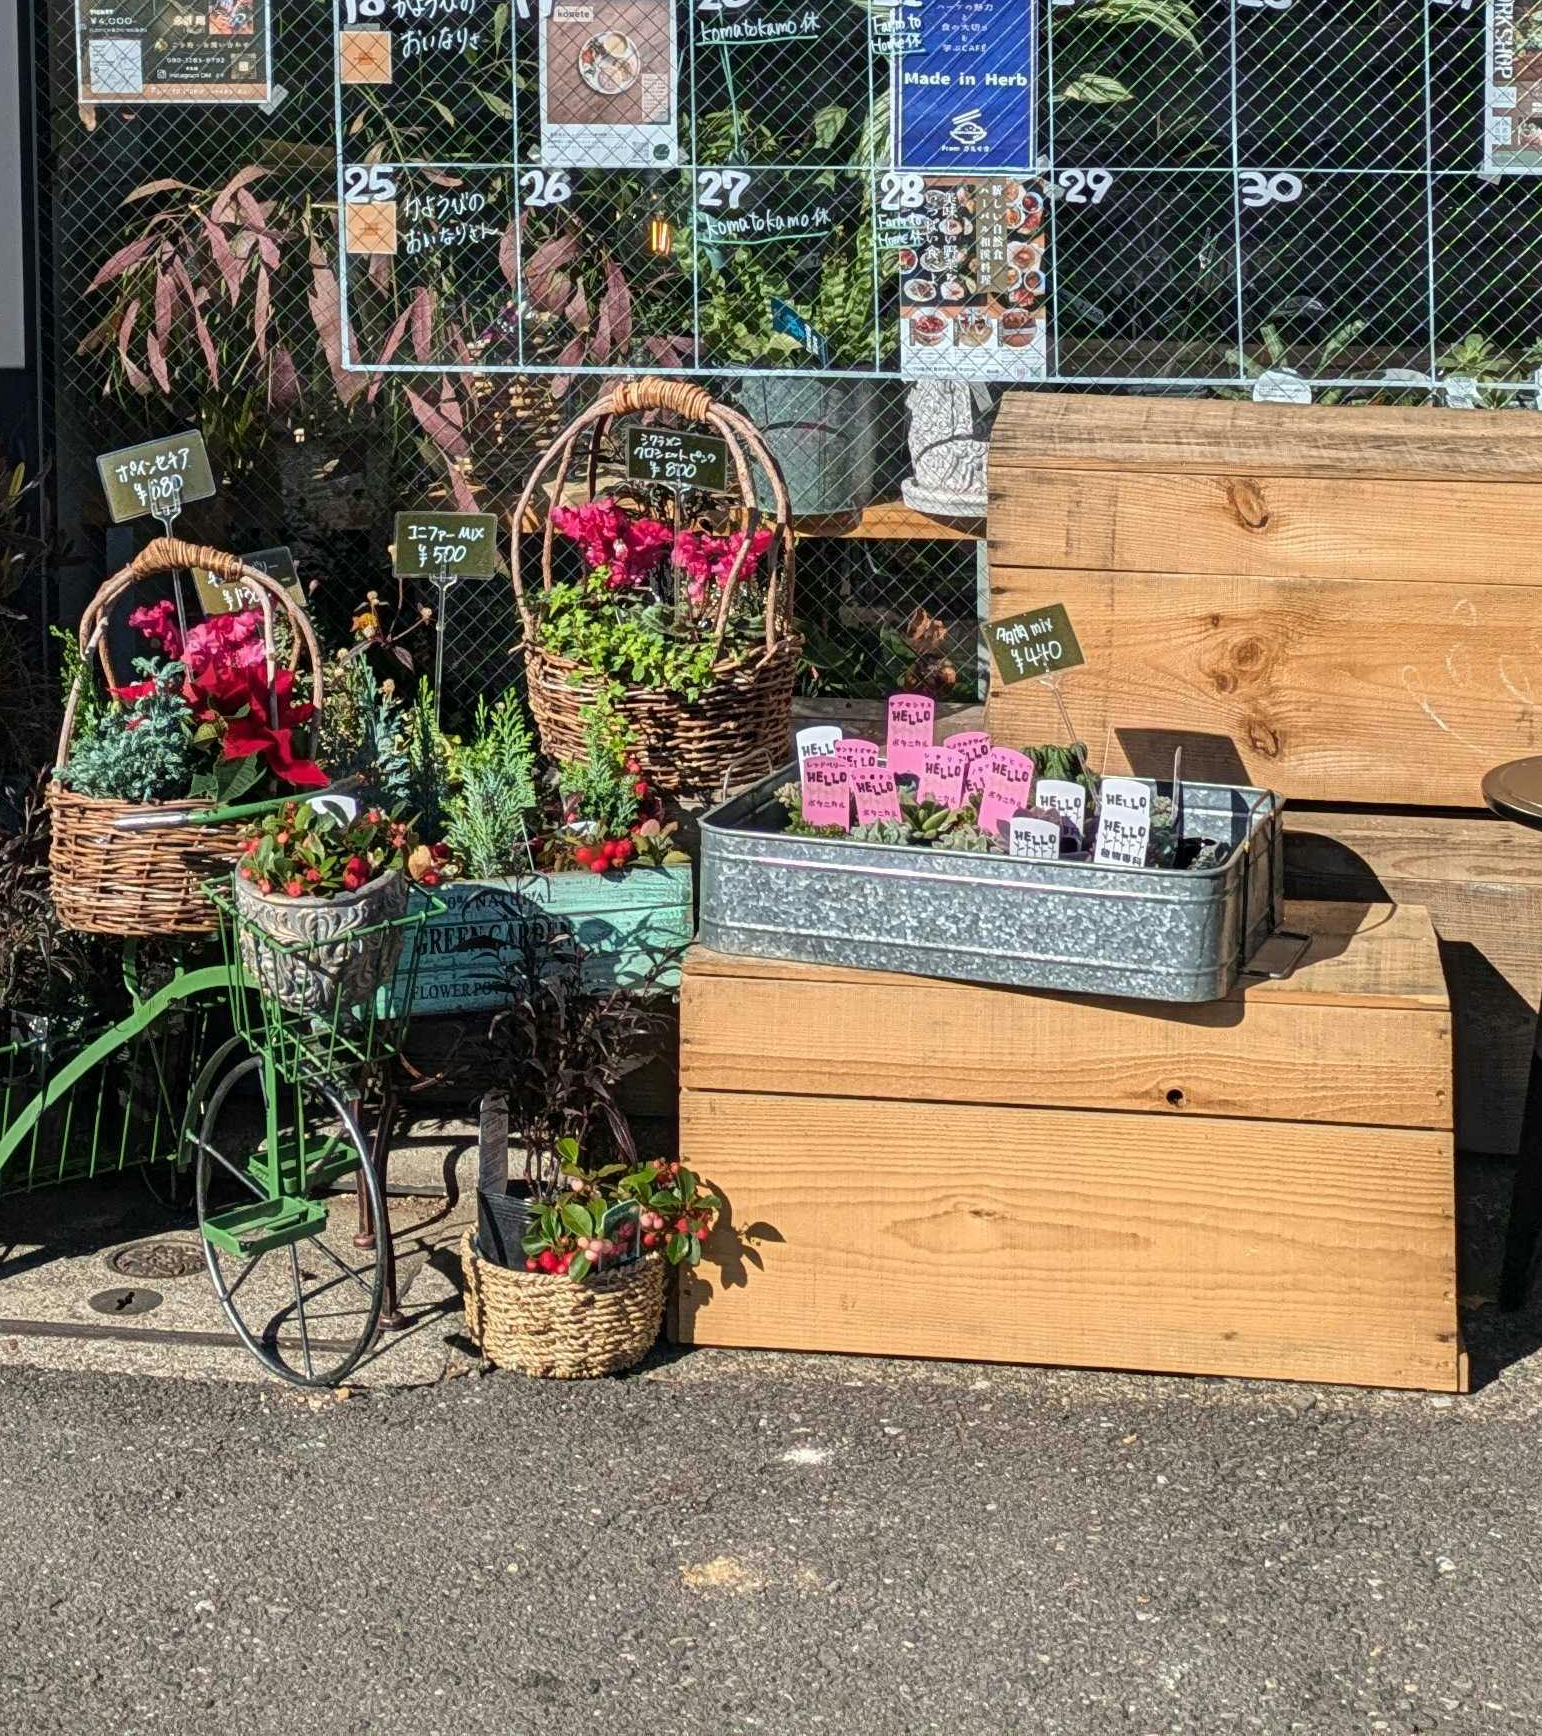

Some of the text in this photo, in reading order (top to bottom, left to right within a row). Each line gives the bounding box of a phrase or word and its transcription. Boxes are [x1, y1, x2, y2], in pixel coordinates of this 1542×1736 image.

[904, 71, 1028, 87] Made in Herb
[344, 166, 397, 203] 25
[520, 171, 572, 205] 26
[697, 170, 751, 209] 27
[881, 173, 924, 211] 28
[1059, 169, 1113, 205] 29
[1238, 172, 1302, 207] 30
[404, 192, 485, 222] かようびの
[650, 462, 697, 478] ¥800
[458, 526, 485, 540] MIX
[418, 544, 466, 567] ¥500
[1030, 617, 1052, 637] mix
[1010, 640, 1062, 675] ¥440
[892, 710, 930, 726] HELLO
[807, 771, 847, 787] HELLO
[925, 763, 961, 779] HELLO
[992, 762, 1029, 782] HELLO
[856, 782, 894, 796] HELLO
[808, 801, 846, 809] ボタニカル
[1040, 795, 1082, 812] HELLO
[1106, 794, 1147, 810] HELLO
[1014, 830, 1056, 845] HELLO
[1104, 819, 1146, 838] HELLO
